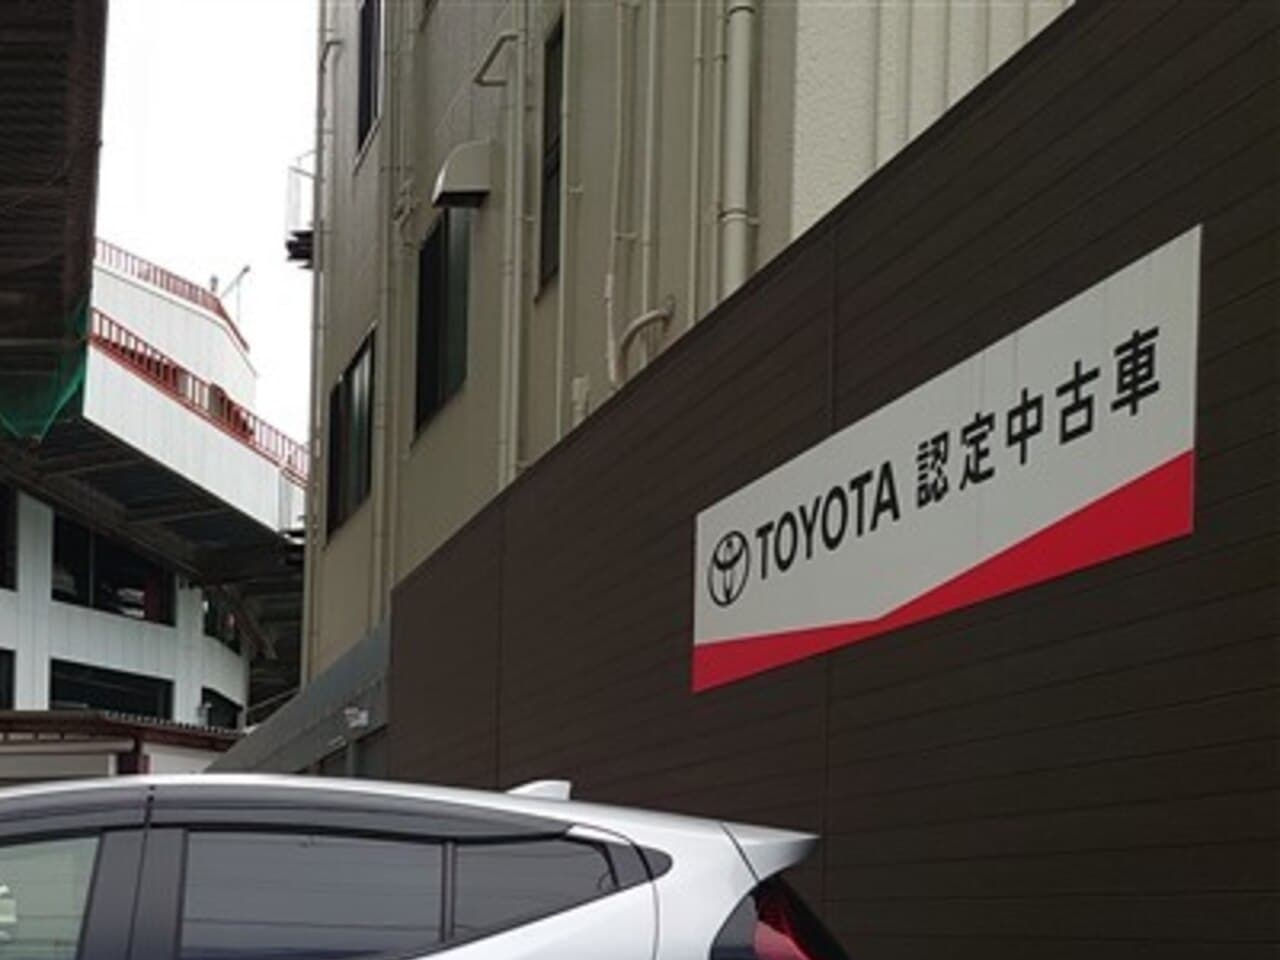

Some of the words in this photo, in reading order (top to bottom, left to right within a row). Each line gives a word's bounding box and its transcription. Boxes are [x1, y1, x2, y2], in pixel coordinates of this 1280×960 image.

[756, 460, 901, 580] TOYOTA
[915, 326, 1161, 509] 認定中古車
